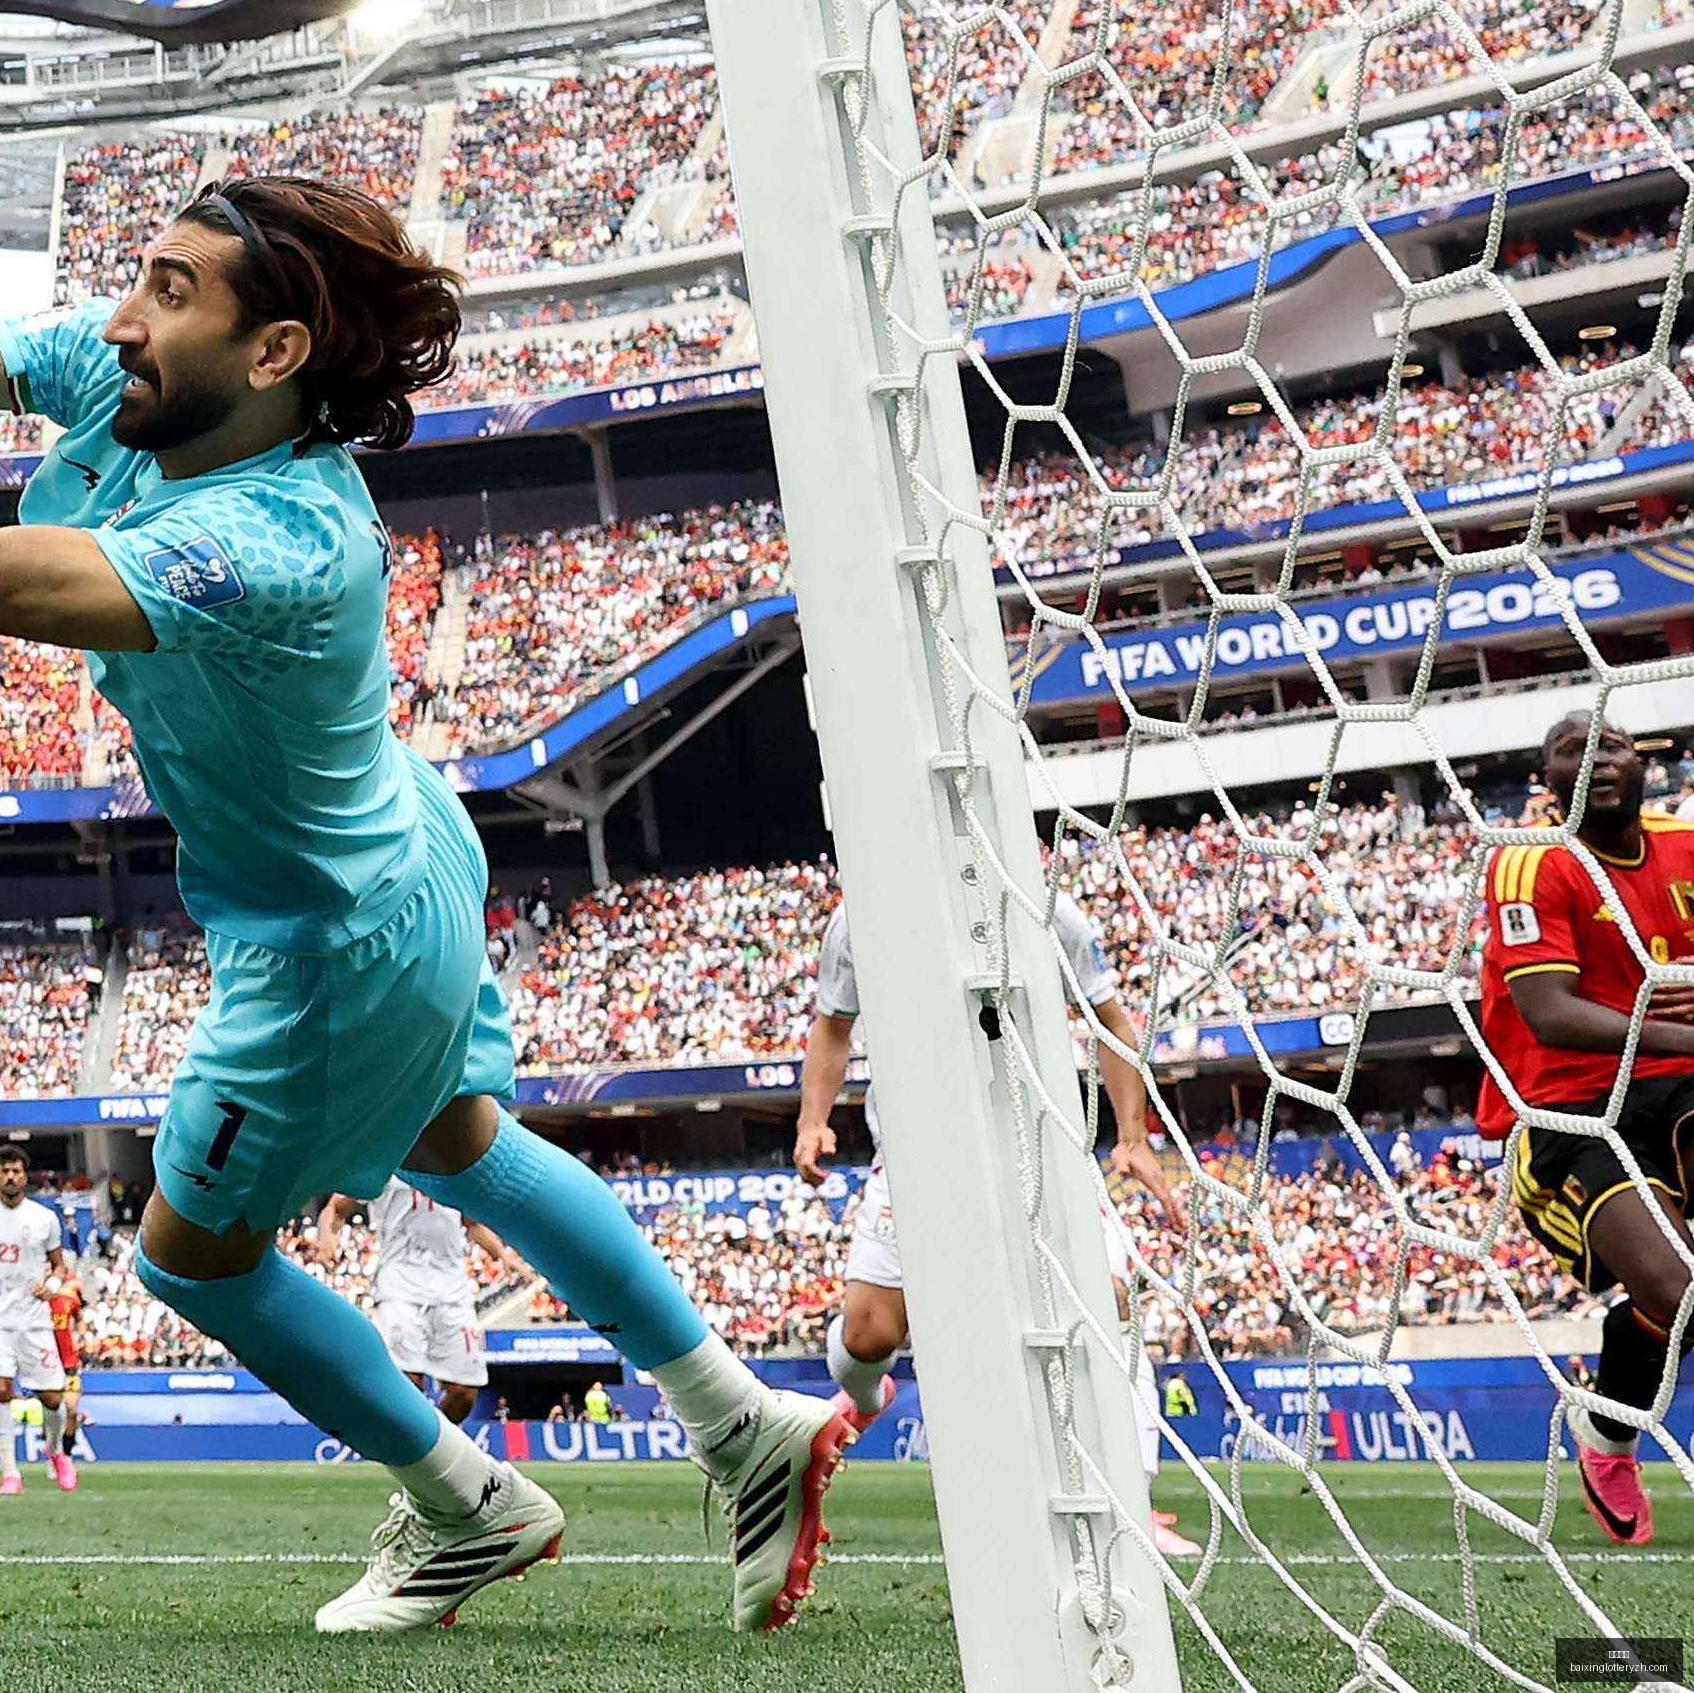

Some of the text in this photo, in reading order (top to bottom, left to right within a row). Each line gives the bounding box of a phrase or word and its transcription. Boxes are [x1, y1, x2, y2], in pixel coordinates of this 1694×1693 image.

[1080, 568, 1622, 687] FIFA WORLD CUP 2026
[745, 1065, 795, 1087] LOS
[206, 1102, 247, 1172] 1
[674, 1178, 734, 1203] CUP
[543, 1421, 693, 1461] ULTR
[1354, 1410, 1476, 1461] ULTRA
